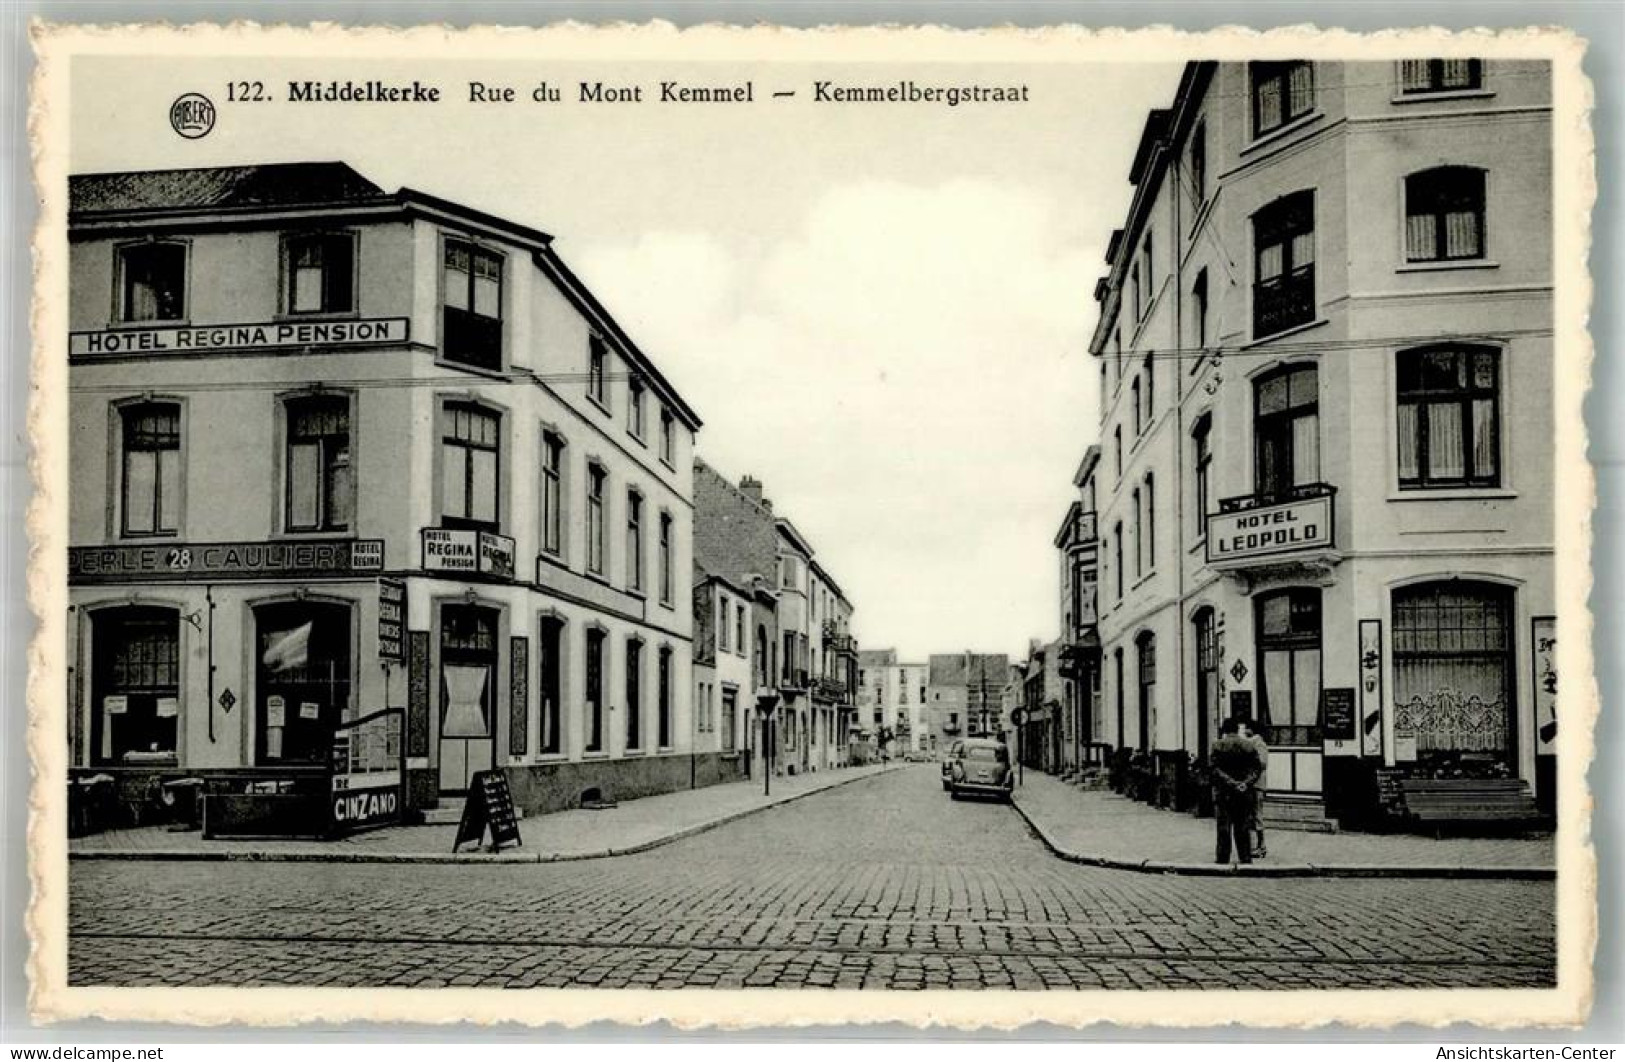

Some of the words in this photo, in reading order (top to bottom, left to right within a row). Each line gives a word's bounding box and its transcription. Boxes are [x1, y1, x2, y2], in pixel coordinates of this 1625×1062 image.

[88, 333, 167, 352] HOTEL
[176, 328, 268, 347] REGINA
[277, 322, 389, 342] PENSION
[1236, 510, 1298, 529] HOTEL
[428, 541, 473, 556] REGINA
[1219, 524, 1318, 552] LEOPOLD
[169, 549, 191, 569] 28
[203, 545, 336, 570] CAULIER
[335, 792, 396, 822] CINZANO
